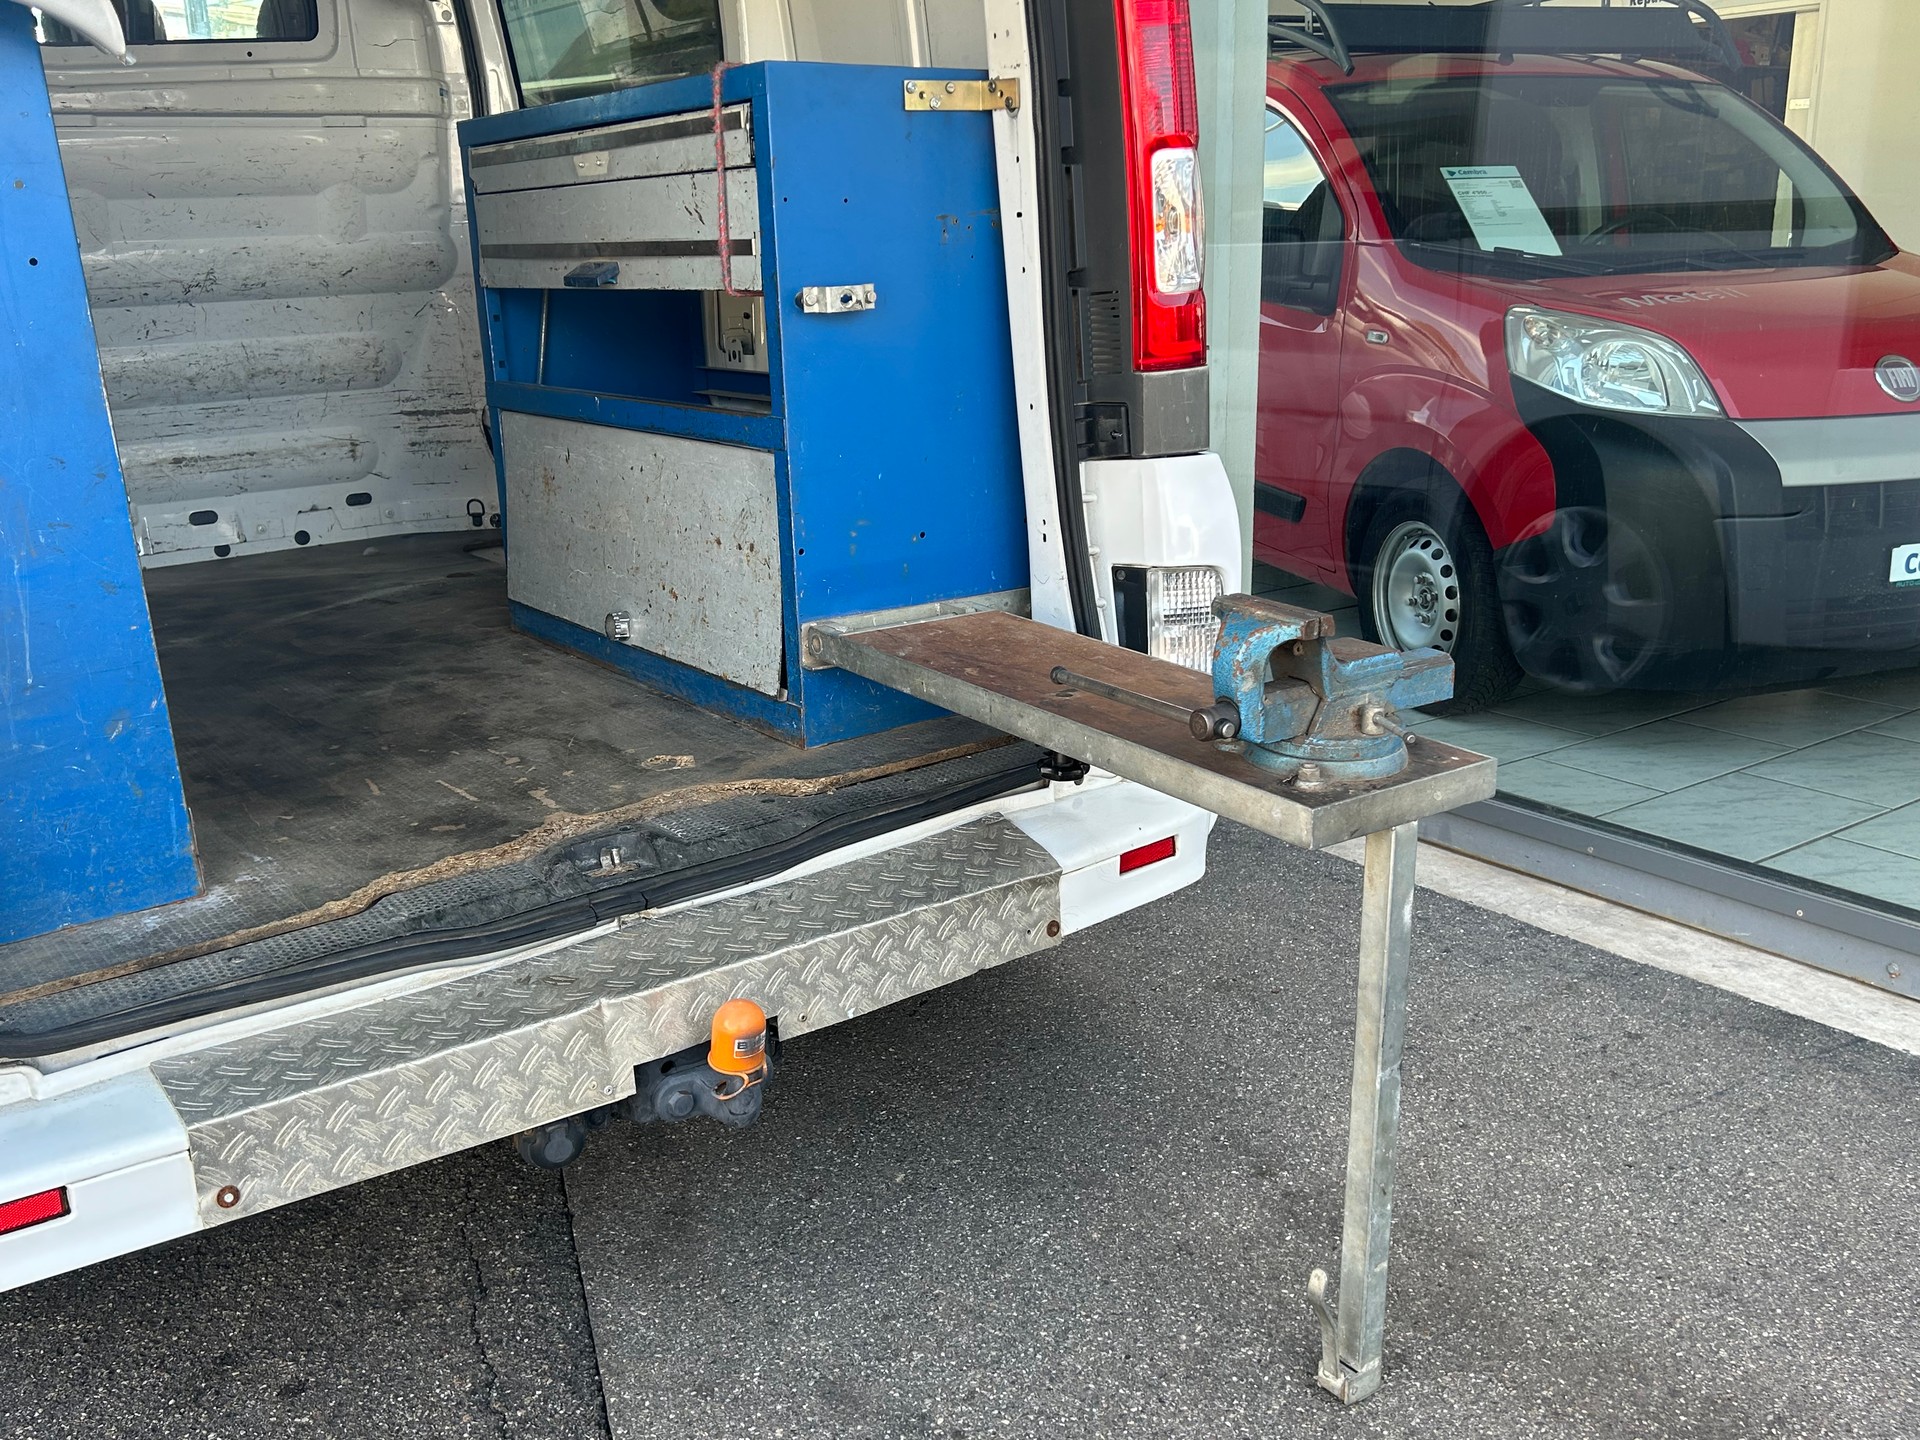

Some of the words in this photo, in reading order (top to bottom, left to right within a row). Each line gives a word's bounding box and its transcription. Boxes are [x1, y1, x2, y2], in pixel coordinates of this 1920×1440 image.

[1620, 287, 1748, 308] Metall
[1886, 367, 1916, 389] FIAT
[1905, 553, 1920, 574] C
